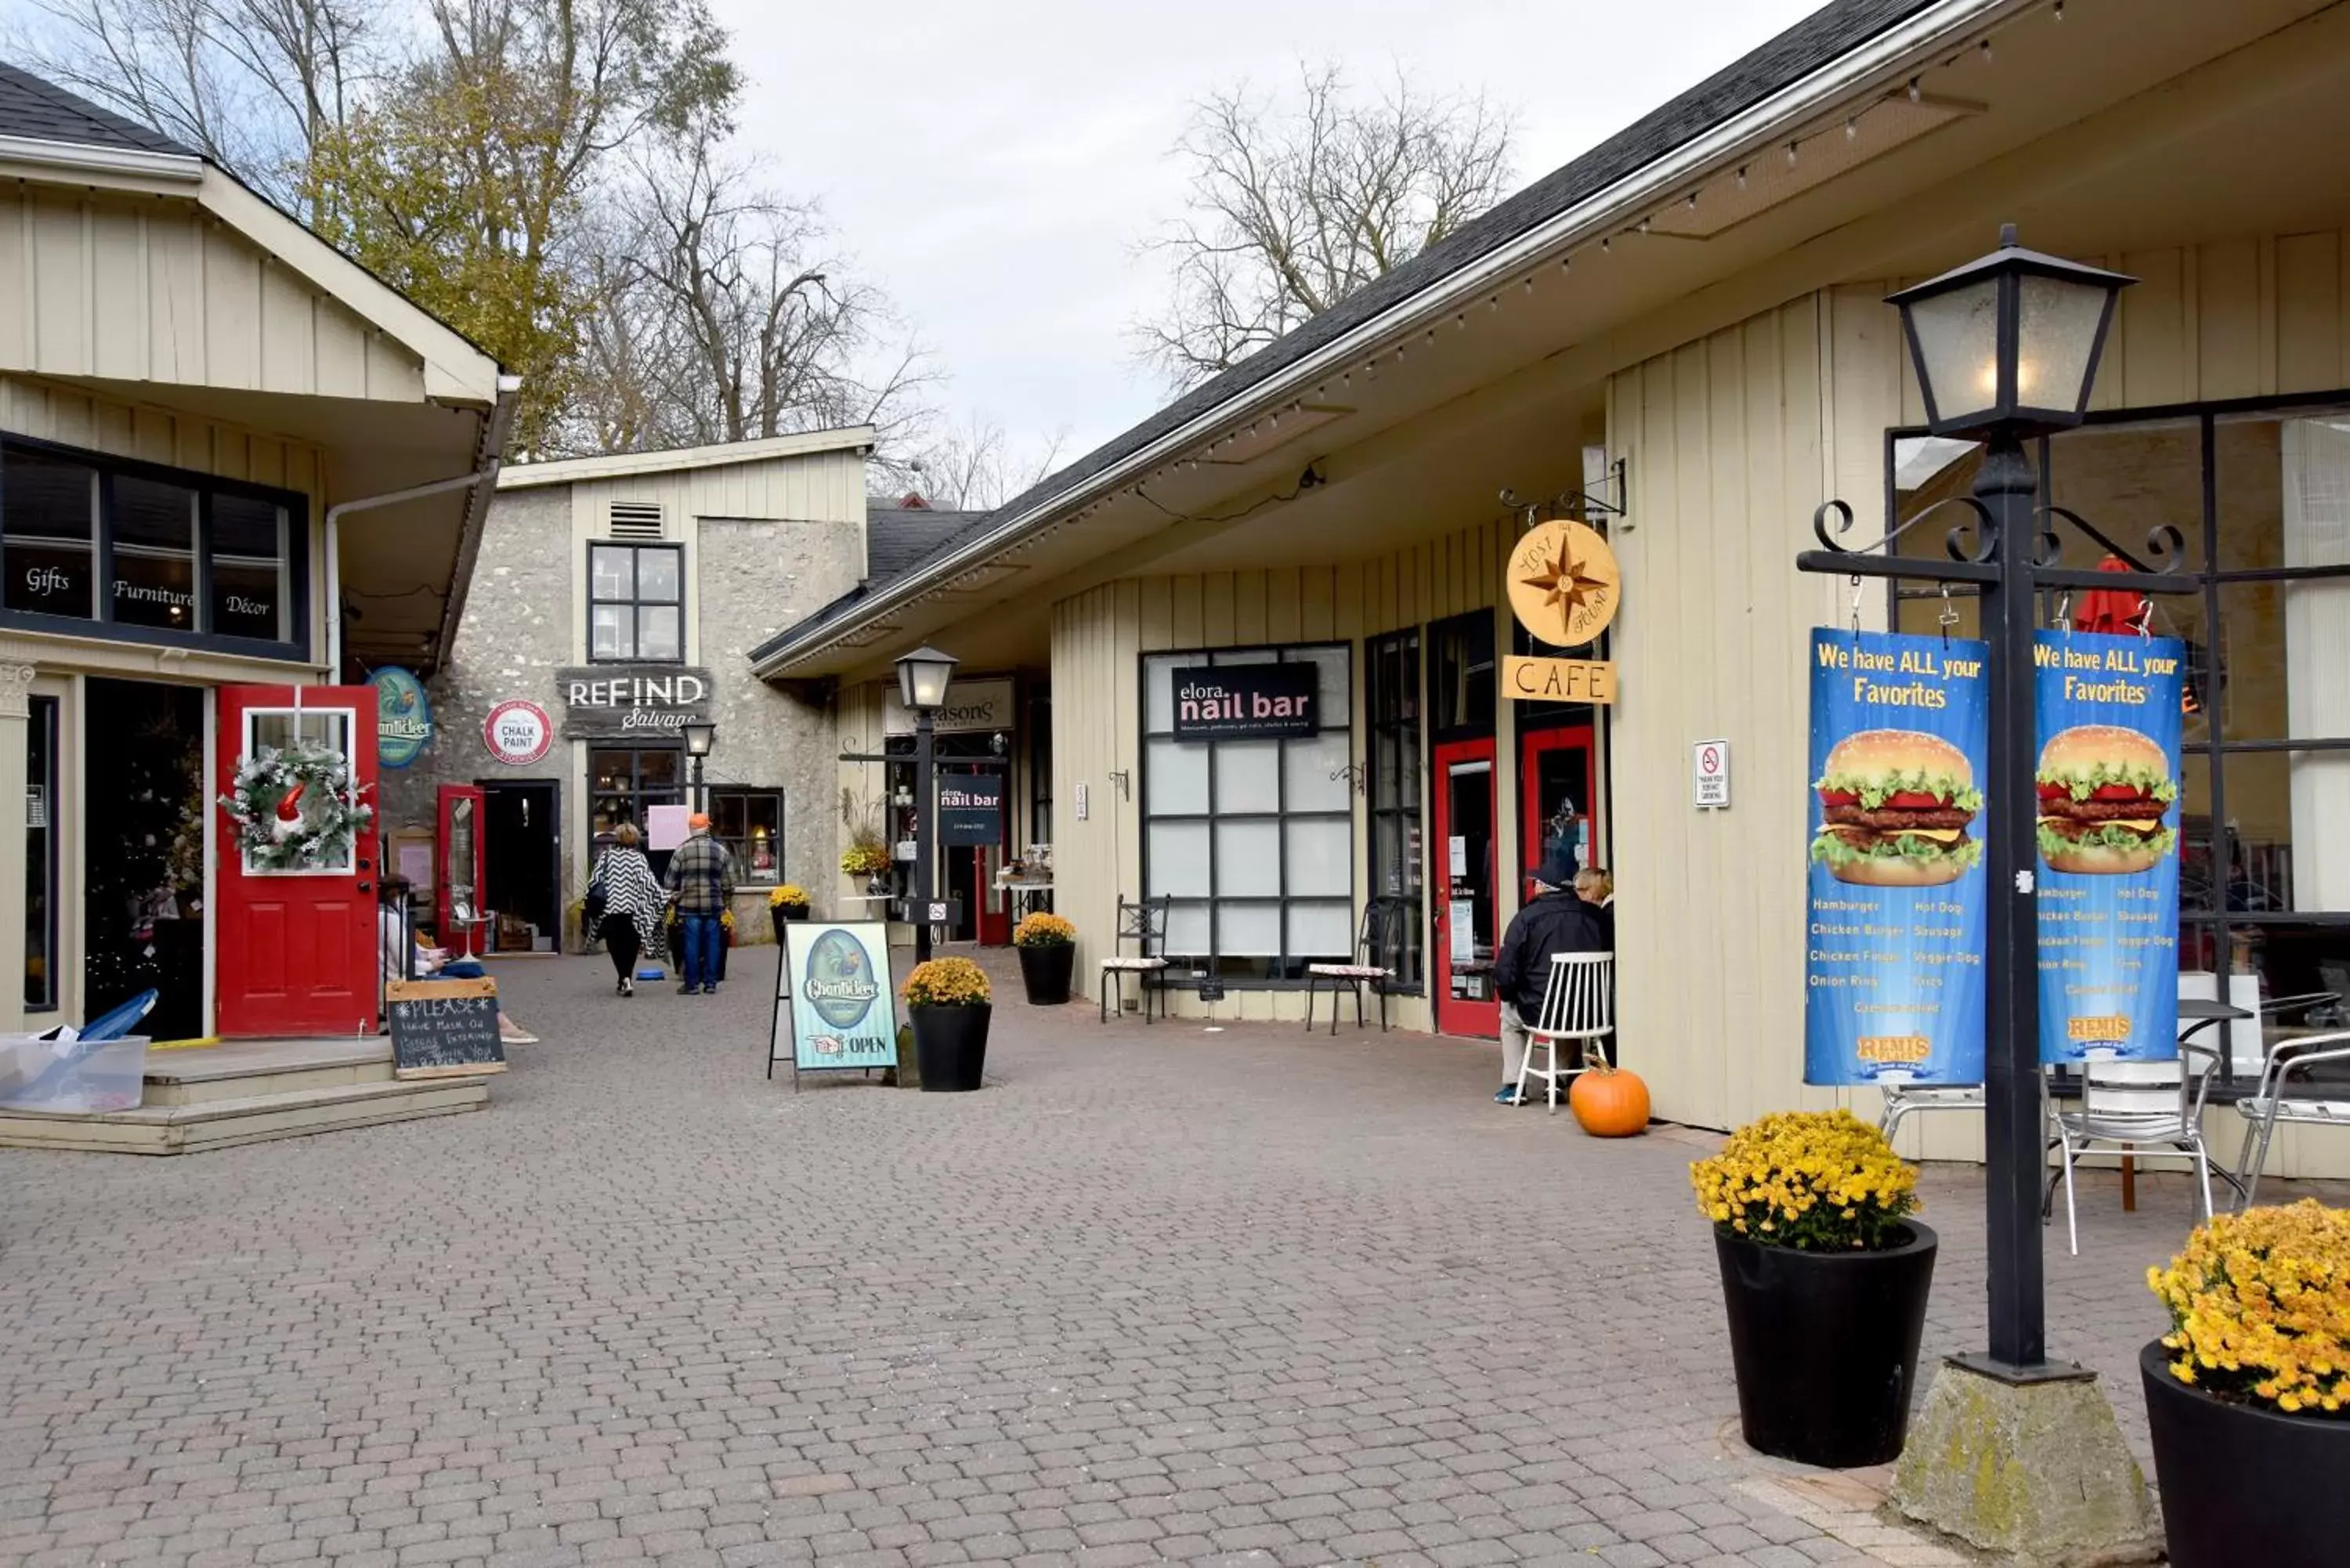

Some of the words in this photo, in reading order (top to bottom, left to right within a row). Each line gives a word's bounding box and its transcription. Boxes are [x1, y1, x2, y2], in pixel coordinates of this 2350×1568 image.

[26, 567, 70, 596] Gifts
[113, 580, 196, 607] Furniture
[226, 595, 269, 616] Décor
[1817, 642, 1848, 668] We
[1853, 646, 1894, 671] have
[1899, 651, 1939, 675] ALL
[1943, 659, 1981, 680] your
[2033, 642, 2059, 668] We
[2064, 647, 2100, 670] have
[2105, 649, 2139, 673] ALL
[2143, 656, 2178, 677] your
[1516, 663, 1605, 698] CAFE
[569, 676, 703, 706] REFIND
[1180, 682, 1224, 699] elora
[1853, 677, 1947, 709] Favorites
[2064, 675, 2146, 704] Favorites
[1180, 692, 1244, 721] nail
[1253, 692, 1309, 718] bar
[502, 726, 534, 736] CHALK
[504, 737, 533, 747] PAINT
[941, 794, 971, 806] nail
[974, 794, 1000, 806] bar
[2037, 888, 2086, 900] amburger
[1813, 898, 1878, 913] Hamburger
[1939, 901, 1963, 915] Dog
[1811, 923, 1860, 935] Chicken
[1810, 950, 1860, 961] Chicken
[1810, 975, 1846, 986] Onion
[849, 1037, 886, 1053] OPEN
